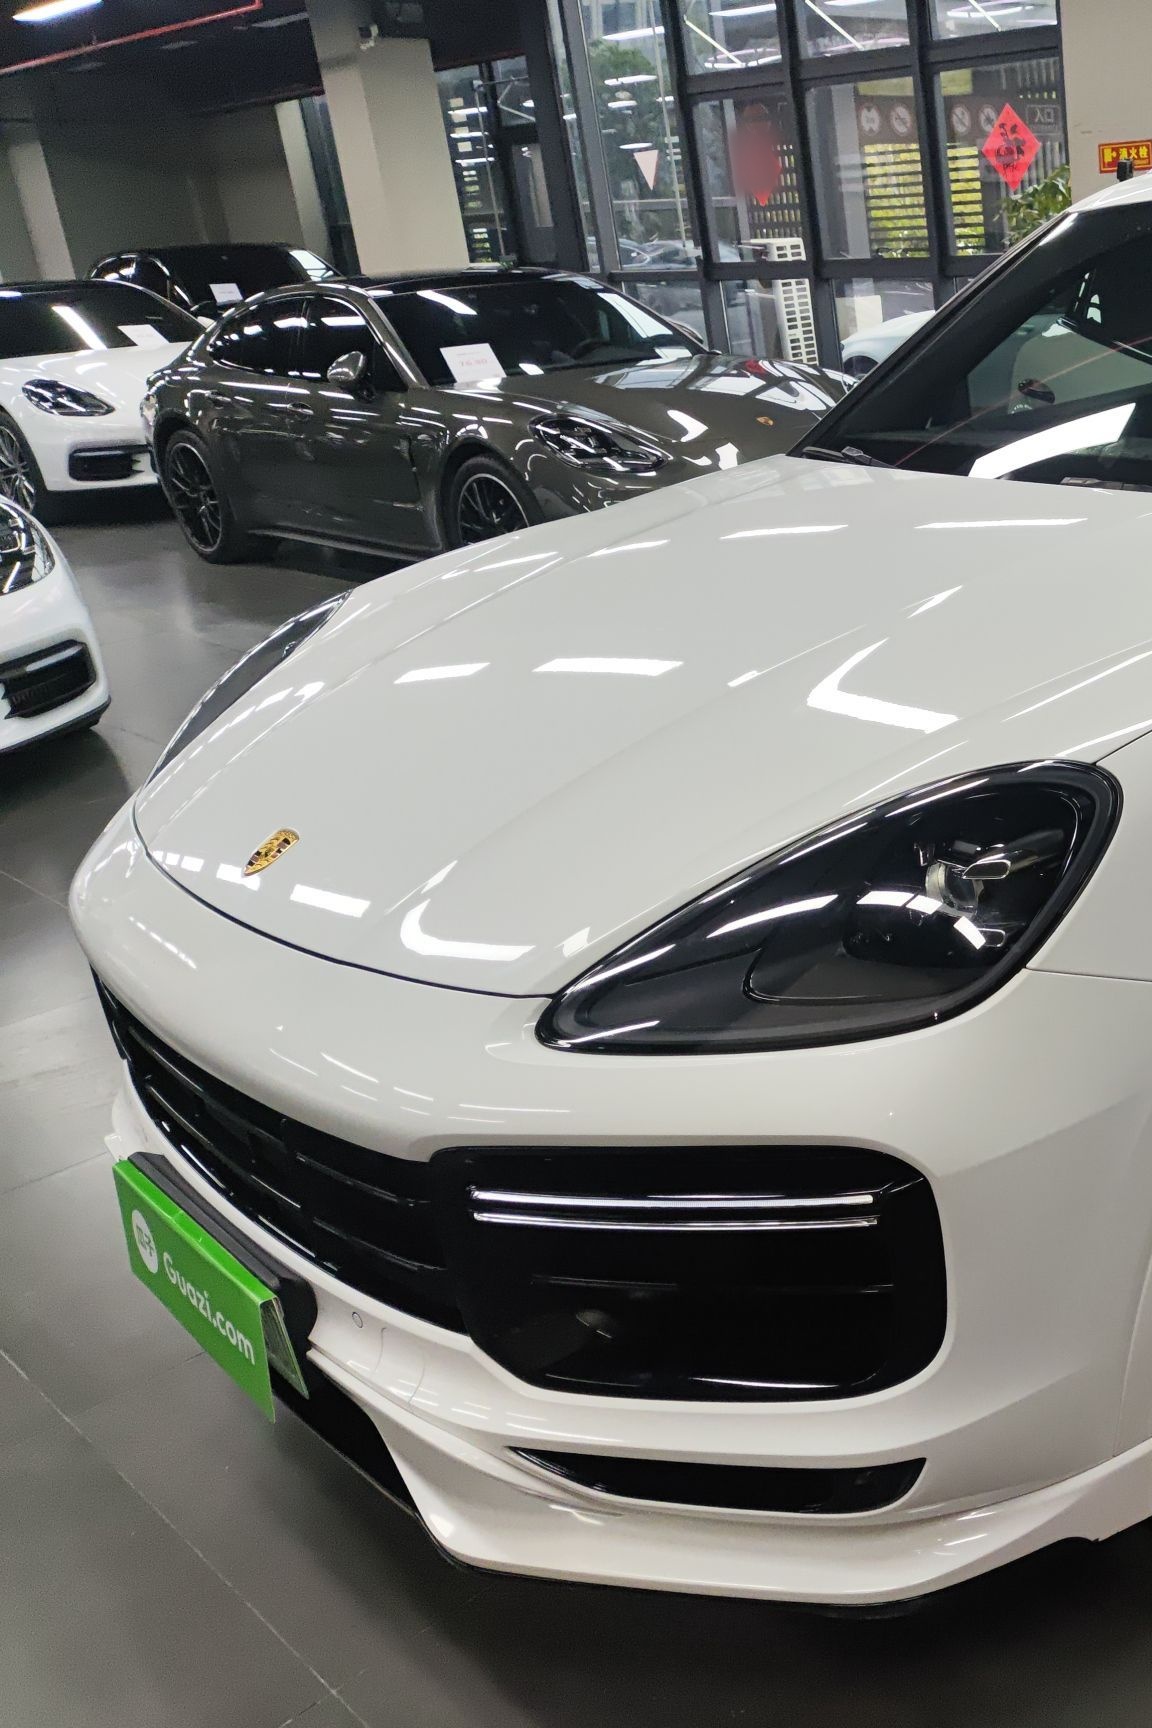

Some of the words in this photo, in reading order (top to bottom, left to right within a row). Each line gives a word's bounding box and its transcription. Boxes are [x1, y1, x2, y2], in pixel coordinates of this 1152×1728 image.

[1119, 145, 1149, 161] 消火栓
[163, 1251, 256, 1366] Guazi.com
